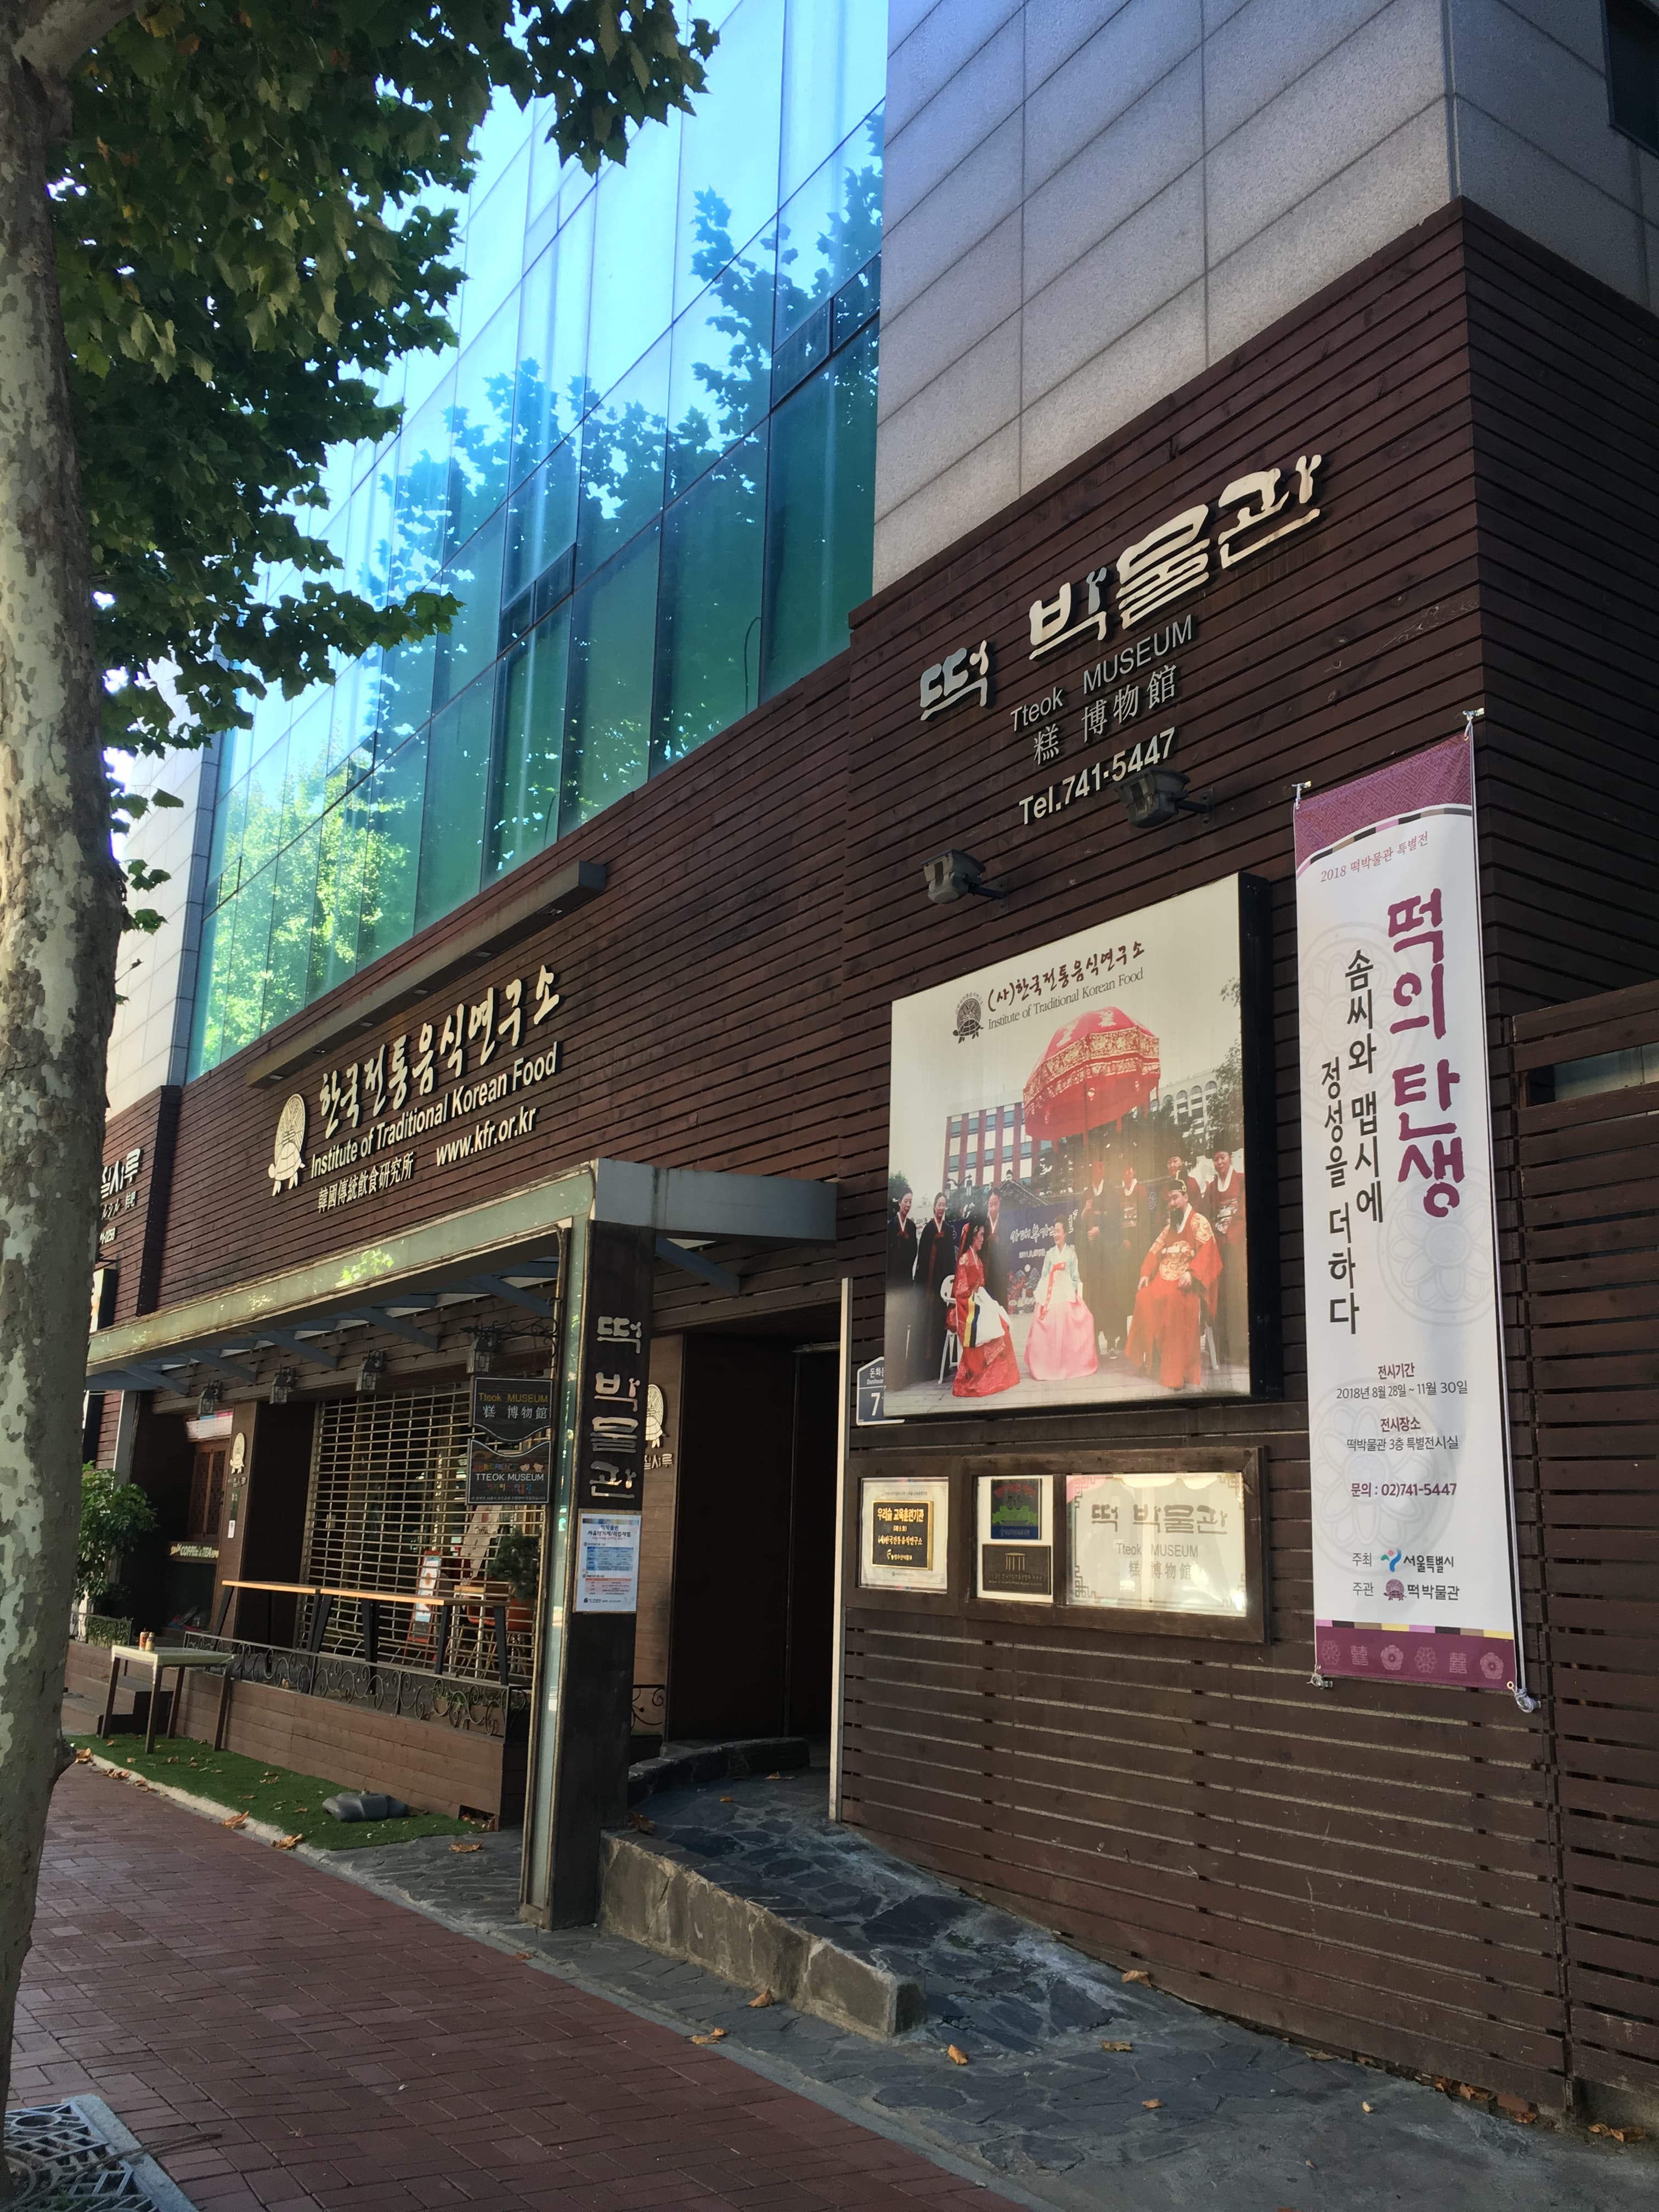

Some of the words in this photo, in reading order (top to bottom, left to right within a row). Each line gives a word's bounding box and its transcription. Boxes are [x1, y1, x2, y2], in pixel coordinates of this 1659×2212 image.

[919, 640, 989, 721] 떡
[1028, 454, 1322, 661] 박물관
[1009, 687, 1064, 732] Tteok
[1082, 614, 1193, 695] MUSEUM
[1033, 723, 1060, 766] 糕
[1081, 664, 1177, 744] 博物館
[1320, 864, 1347, 883] 2018
[1350, 846, 1394, 875] 떡박물관
[1397, 831, 1429, 858] 특별전
[988, 941, 1145, 1012] (사)한국전통음식연구소
[1387, 888, 1447, 1040] 떡의
[988, 1012, 1020, 1030] Institute
[1022, 1008, 1031, 1019] of
[1033, 988, 1079, 1014] Traditional
[1082, 979, 1115, 999] Korean
[1118, 967, 1144, 987] Food
[1345, 949, 1377, 1074] 솜씨와
[319, 964, 560, 1139] 한국전통음식연구소
[311, 1143, 358, 1178] Institute
[360, 1133, 375, 1157] of
[376, 1093, 449, 1151] Traditional
[452, 1073, 507, 1118] Korean
[512, 1041, 557, 1091] Food
[436, 1105, 537, 1167] www.kfr.or.kr
[1321, 1057, 1348, 1189] 정성을
[1391, 1058, 1465, 1218] 탄생
[1351, 1090, 1383, 1223] 맵시에
[1328, 1201, 1360, 1335] 더하다
[596, 1316, 642, 1354] 떡
[507, 1394, 548, 1403] MUSEUM
[1336, 1386, 1370, 1400] 2018년
[1372, 1385, 1386, 1399] 8월
[1388, 1384, 1407, 1397] 28일
[1417, 1381, 1437, 1396] 11월
[1440, 1380, 1468, 1395] 30일
[1378, 1362, 1415, 1380] 전시기간
[507, 1405, 548, 1419] 博物館
[589, 1372, 641, 1499] 박물관
[1380, 1417, 1421, 1433] 전시장소
[1347, 1438, 1387, 1452] 떡박물관
[1389, 1437, 1404, 1451] 3층
[1406, 1435, 1459, 1450] 특별전시실
[476, 1473, 505, 1481] TTEOK
[507, 1473, 544, 1482] MUSEUM
[1351, 1482, 1372, 1498] 문의
[1380, 1482, 1457, 1498] 02)741-5447
[1091, 1504, 1119, 1533] 떡
[1132, 1504, 1228, 1535] 박물관
[1116, 1543, 1143, 1556] Tteok
[1151, 1544, 1199, 1558] MUSEUM
[1150, 1561, 1192, 1581] 博物館
[1352, 1553, 1372, 1567] 주최
[1403, 1555, 1454, 1573] 서울특별시
[1352, 1582, 1374, 1597] 주관
